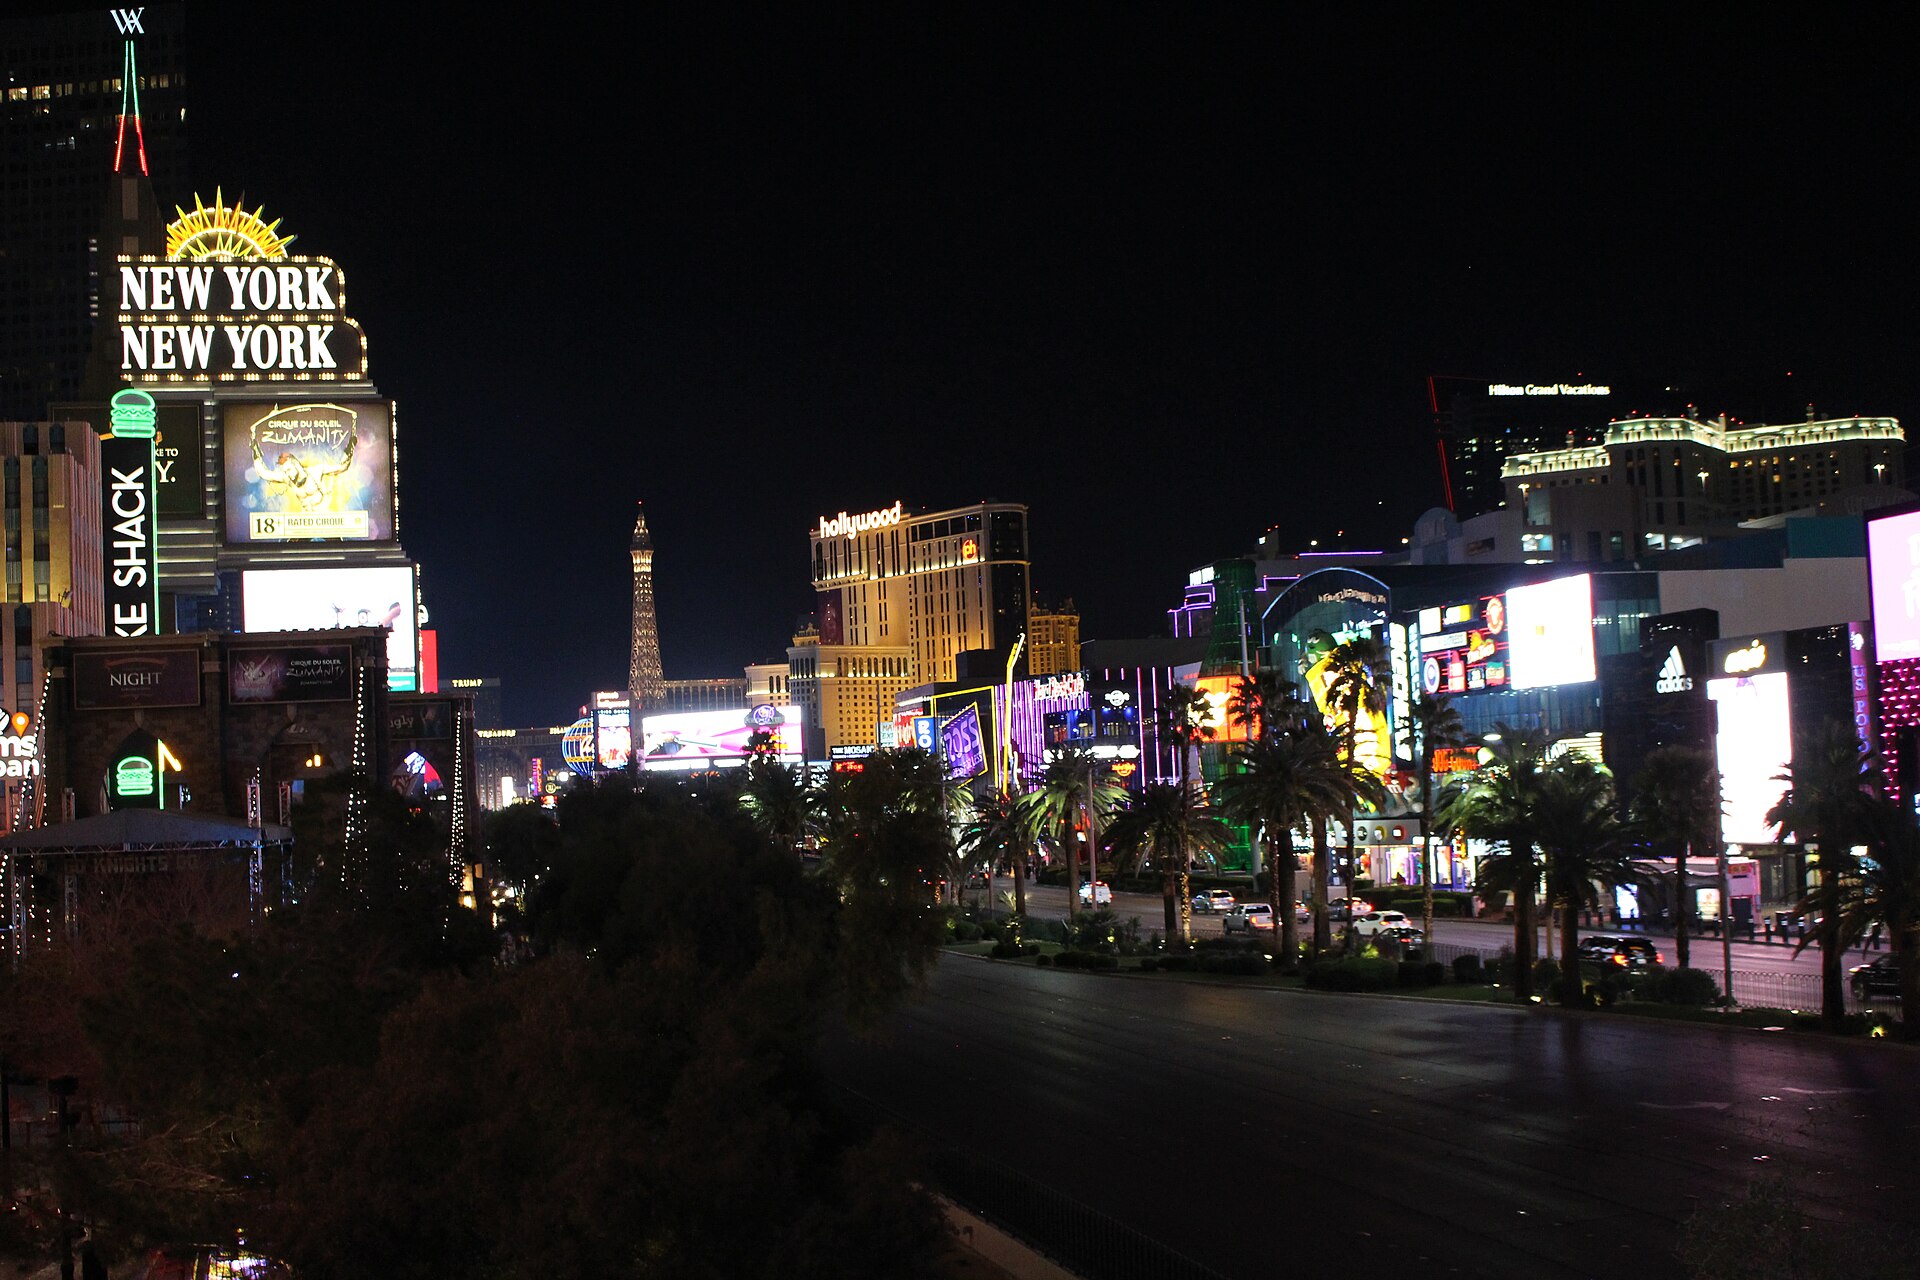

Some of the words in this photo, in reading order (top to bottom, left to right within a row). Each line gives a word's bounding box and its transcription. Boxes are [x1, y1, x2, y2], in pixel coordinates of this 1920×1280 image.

[120, 265, 214, 311] NEW
[223, 265, 335, 310] YORK
[121, 325, 215, 370] NEW
[224, 325, 337, 369] YORK
[1488, 384, 1524, 396] Hilton
[1525, 383, 1558, 396] Grand
[1559, 383, 1611, 396] Vacations
[267, 420, 299, 430] CIRQUE
[300, 420, 313, 429] DU
[314, 419, 342, 429] SOLEIL
[261, 428, 349, 450] ZUMANITY
[165, 447, 179, 457] TO
[110, 466, 148, 588] SHACK
[287, 517, 314, 527] RATED
[315, 517, 345, 526] CIRQUE
[819, 500, 902, 542] hollywood
[322, 658, 342, 666] SOLEIL
[110, 672, 162, 687] NIGHT
[286, 663, 346, 681] ZUMANITY
[452, 678, 483, 688] TRUMP
[1656, 676, 1693, 694] adidas
[477, 729, 517, 739] TREASURE
